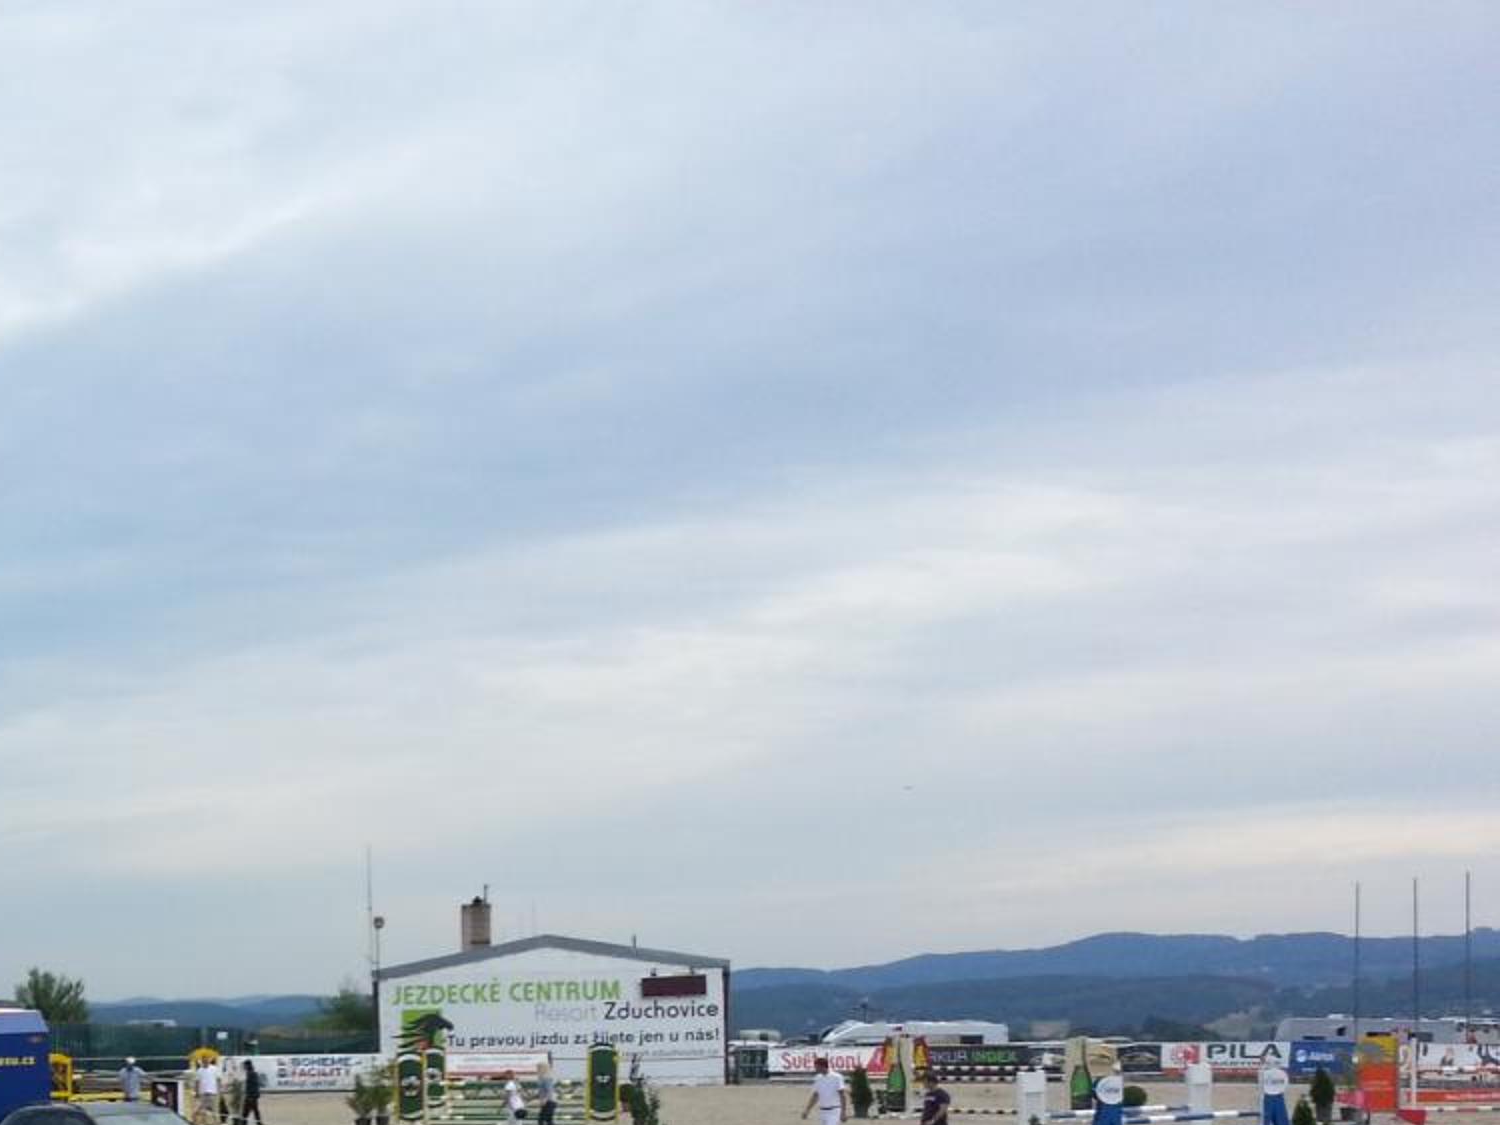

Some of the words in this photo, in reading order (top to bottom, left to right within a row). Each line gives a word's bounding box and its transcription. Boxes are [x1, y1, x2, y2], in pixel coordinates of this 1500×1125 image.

[391, 977, 500, 1005] JEZDECKÉ
[508, 981, 620, 1003] CENTRUM
[603, 1000, 718, 1020] Zduchovice
[448, 1034, 464, 1047] Tu
[469, 1034, 524, 1049] pravou
[638, 1030, 663, 1046] jen
[668, 1031, 678, 1042] u
[683, 1028, 718, 1041] nás!
[1206, 1043, 1282, 1058] PILA
